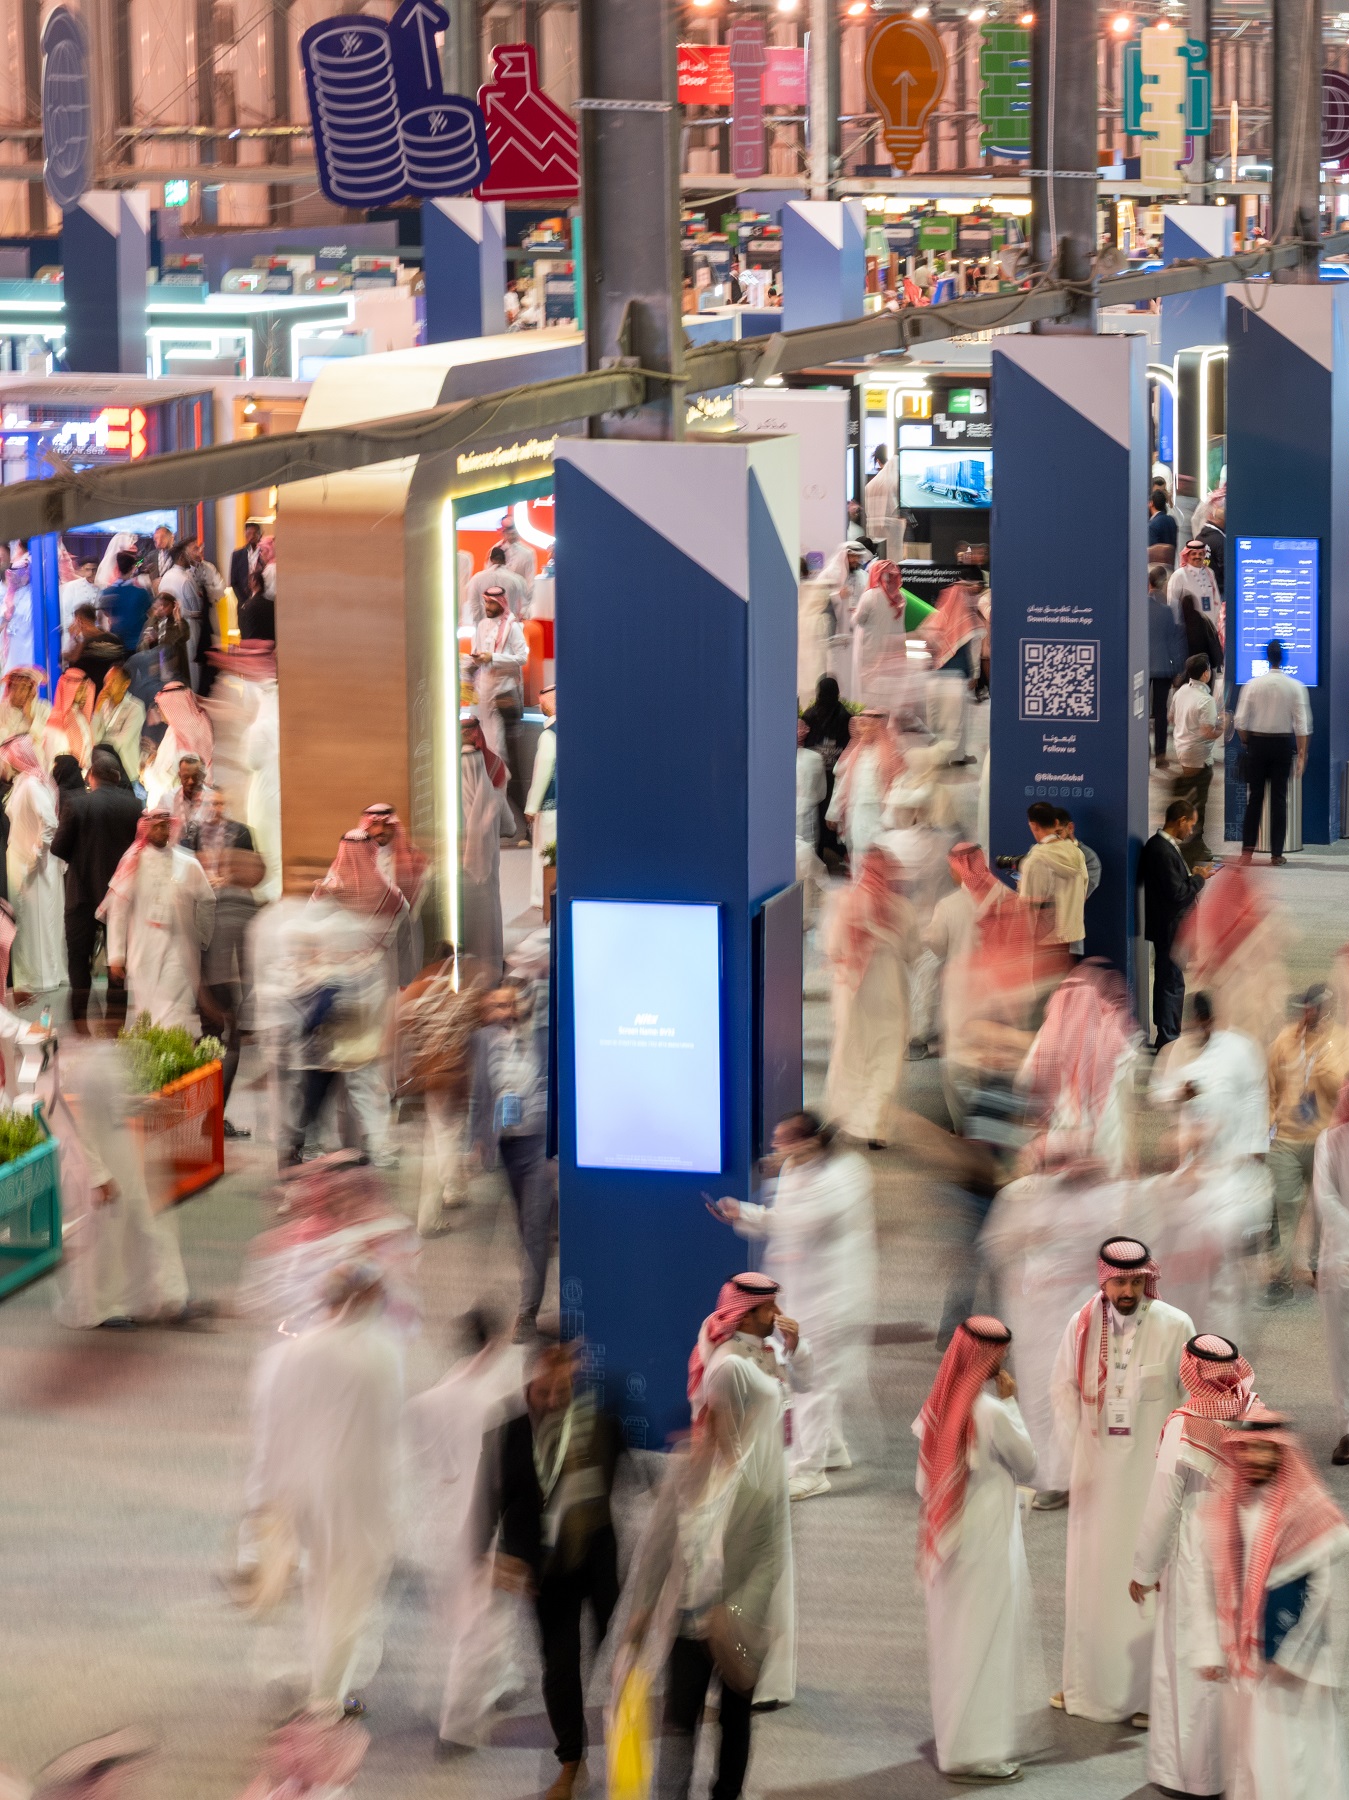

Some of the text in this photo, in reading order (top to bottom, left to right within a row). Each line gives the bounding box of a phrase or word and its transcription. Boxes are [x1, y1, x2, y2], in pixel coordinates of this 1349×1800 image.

[1027, 615, 1093, 625] Download Biban App
[1042, 745, 1066, 753] Follow
[1034, 772, 1084, 783] @BibanGlobal
